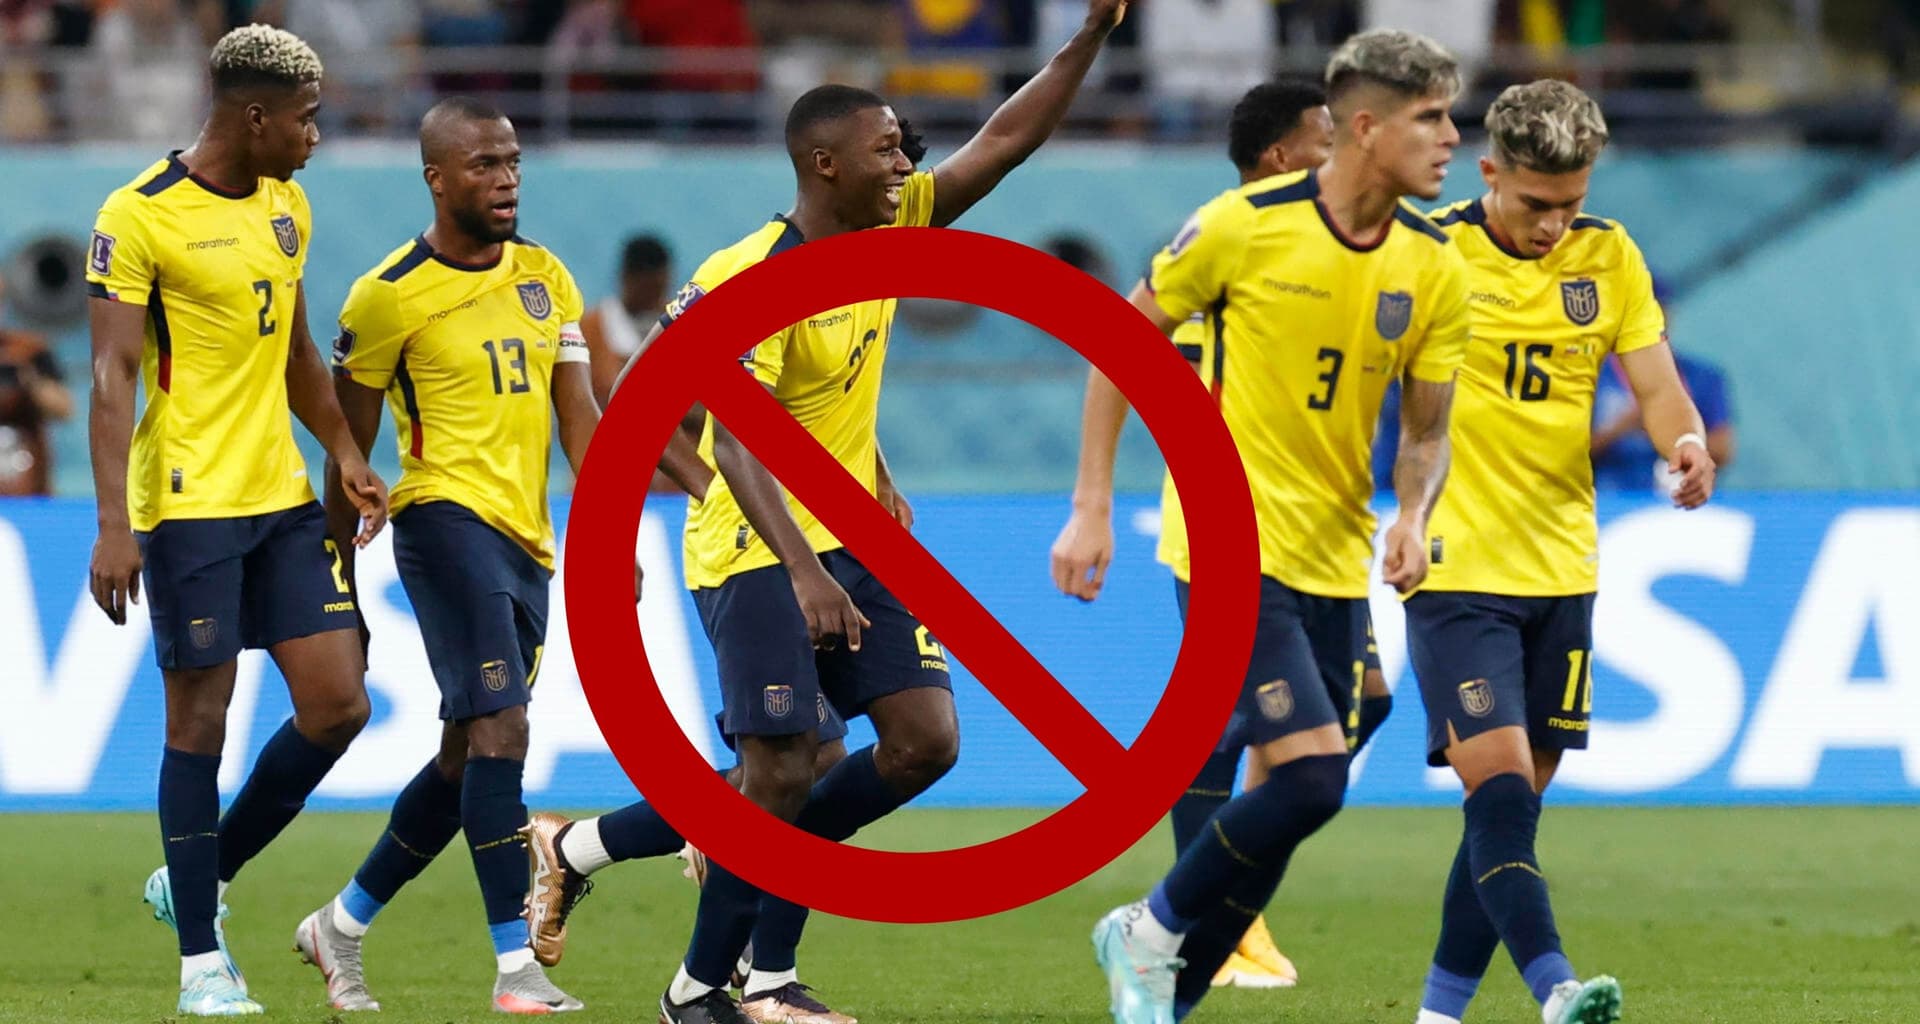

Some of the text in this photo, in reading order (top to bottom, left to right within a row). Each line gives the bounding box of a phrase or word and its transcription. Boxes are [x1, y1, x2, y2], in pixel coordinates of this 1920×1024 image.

[187, 237, 239, 251] marathon
[253, 279, 276, 337] 2
[1263, 277, 1333, 300] marathon
[482, 338, 531, 395] 13
[1307, 347, 1345, 411] 3
[1503, 341, 1553, 402] 16
[324, 539, 350, 594] 2
